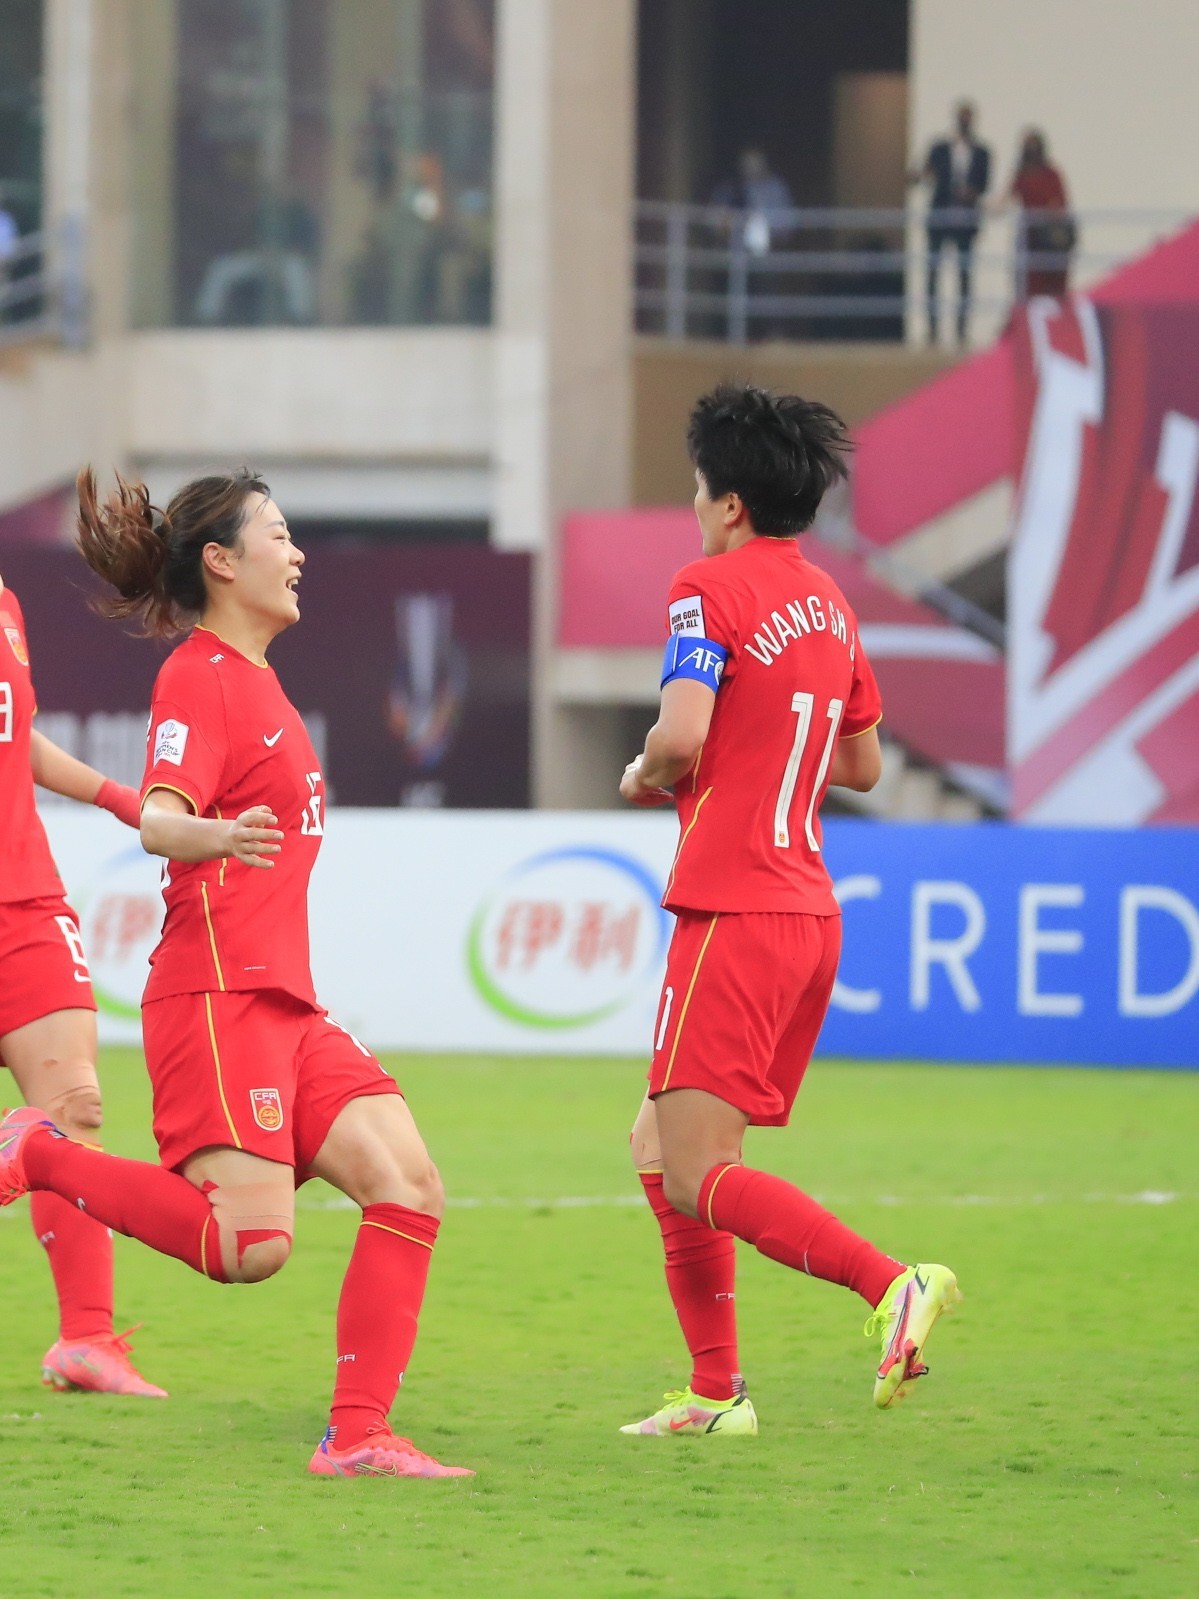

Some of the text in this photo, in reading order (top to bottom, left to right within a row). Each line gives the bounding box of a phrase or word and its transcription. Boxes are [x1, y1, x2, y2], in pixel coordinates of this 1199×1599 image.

[671, 608, 700, 625] OUR GOAL
[673, 618, 699, 632] FOR ALL
[743, 595, 827, 666] WANG
[773, 691, 844, 852] 11
[830, 874, 1199, 1018] CRED
[254, 1092, 277, 1100] CFA
